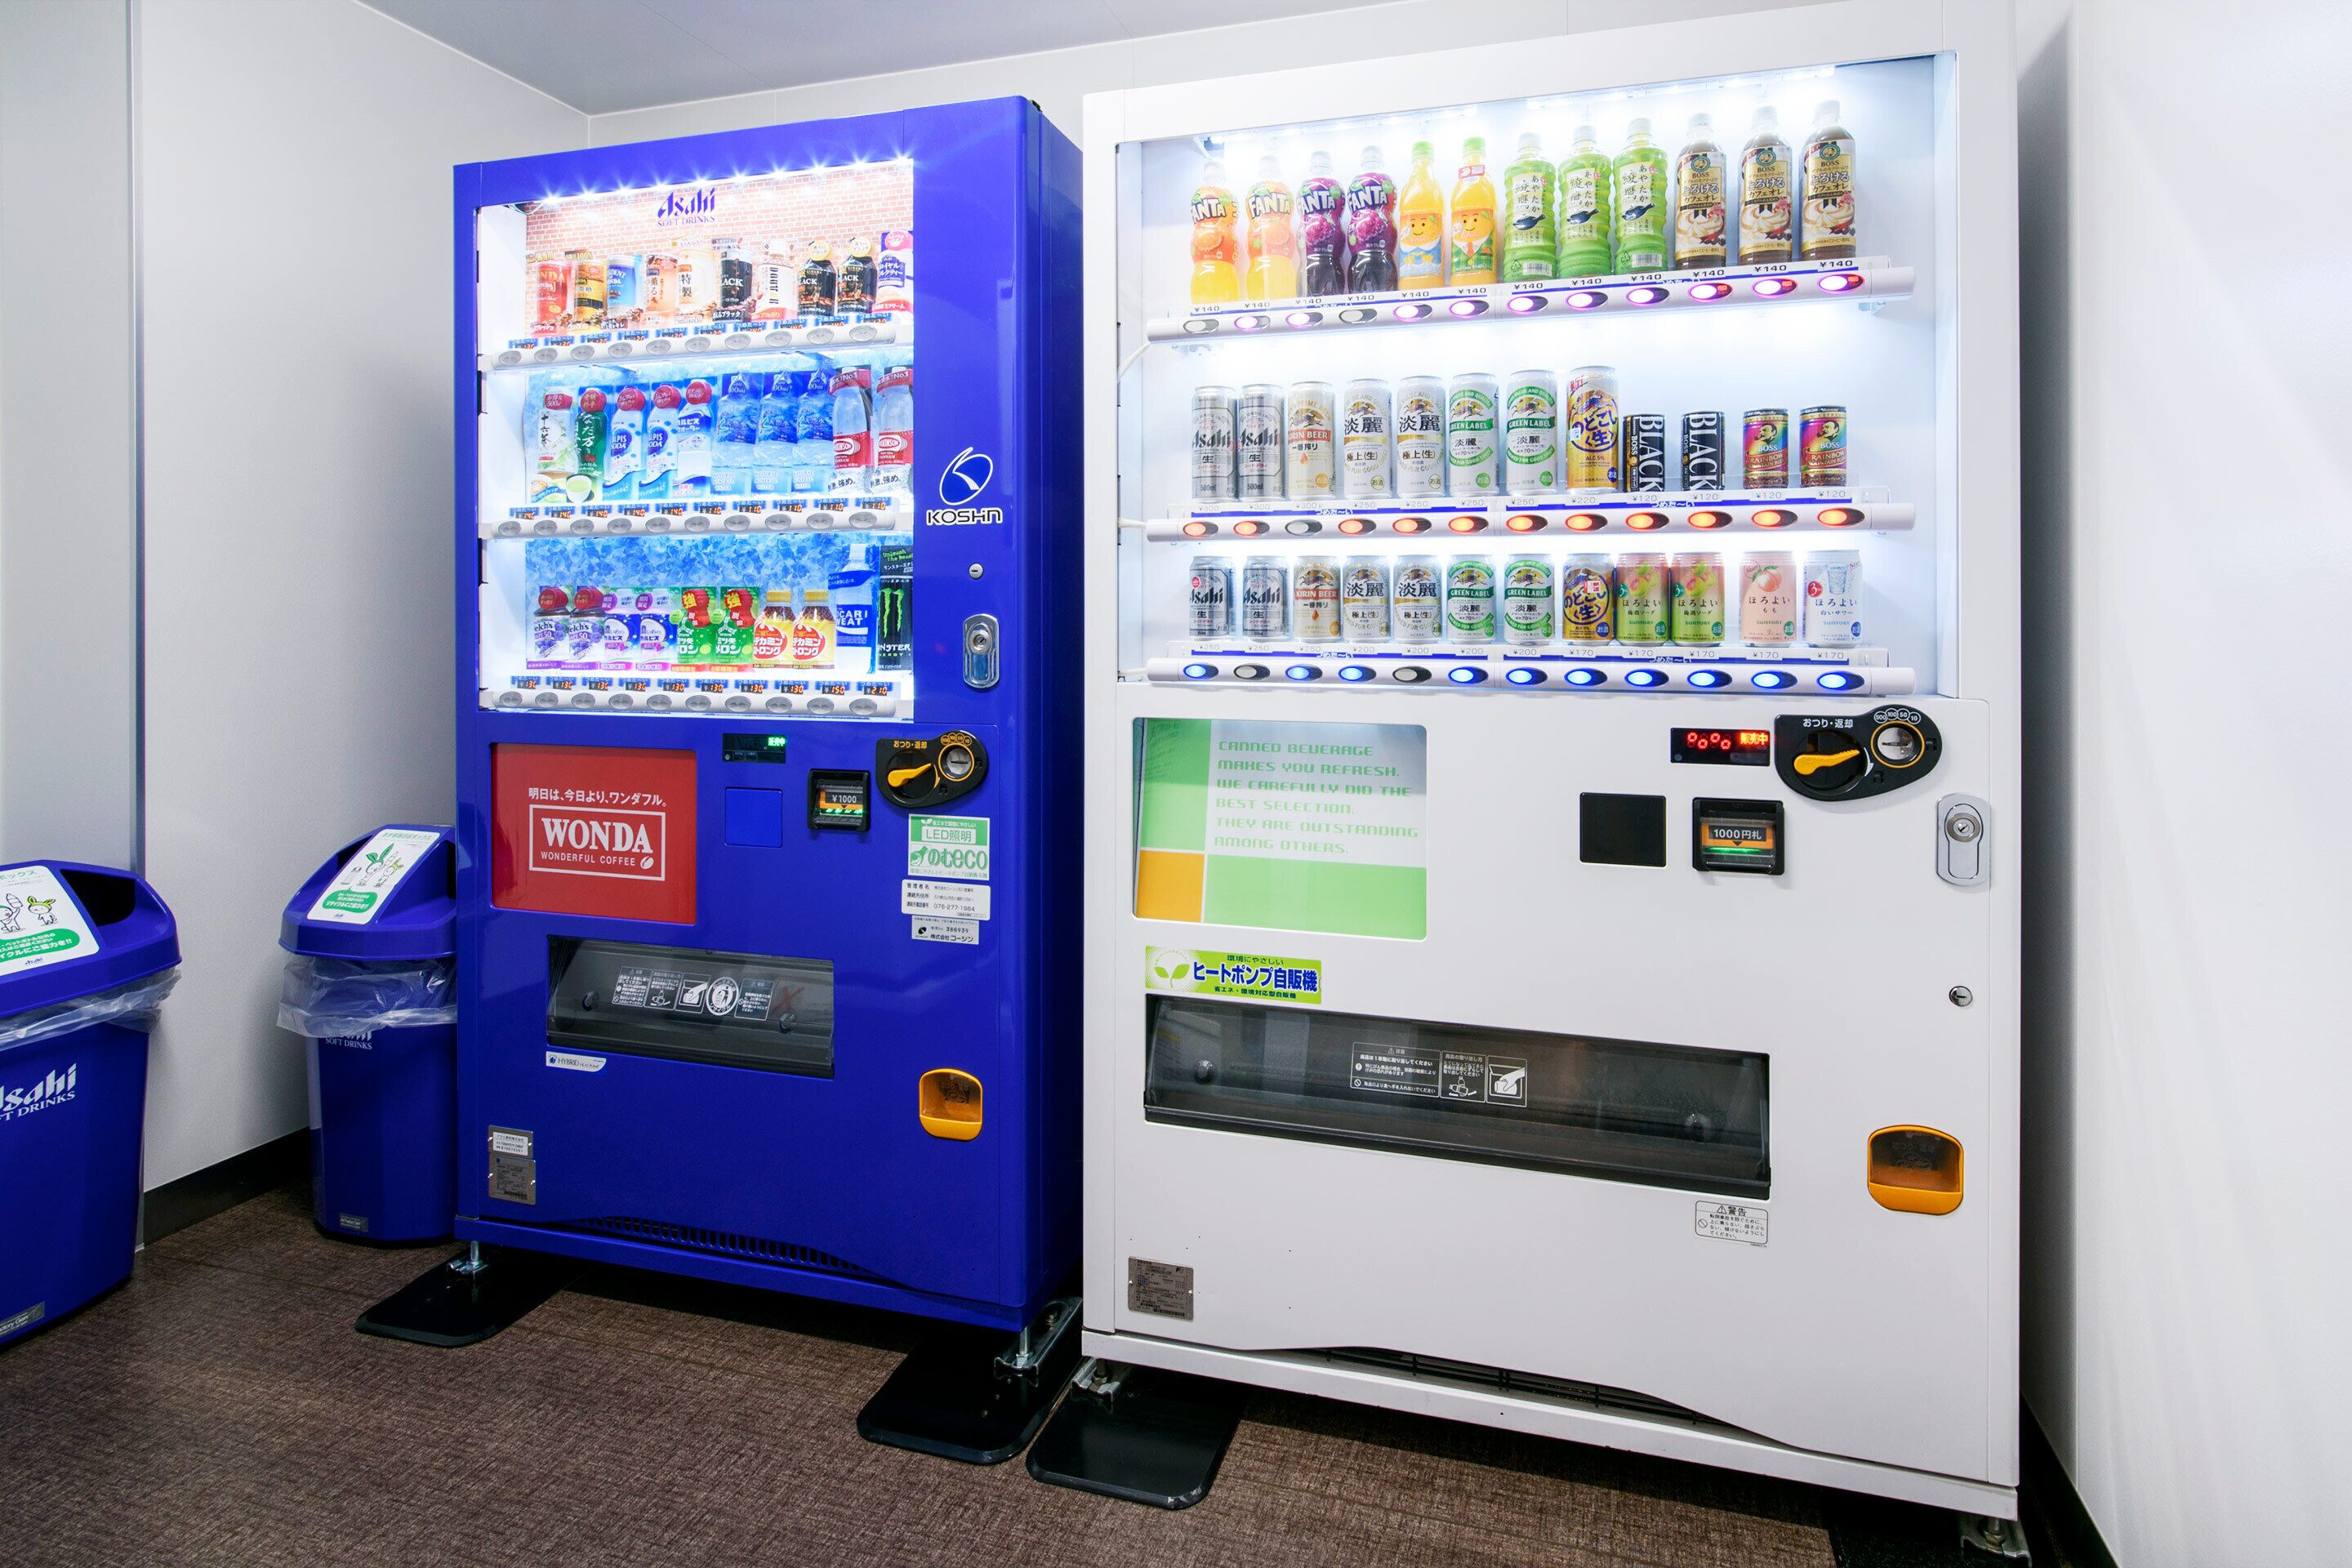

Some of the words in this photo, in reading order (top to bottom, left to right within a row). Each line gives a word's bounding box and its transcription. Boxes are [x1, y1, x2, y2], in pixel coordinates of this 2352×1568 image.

[1639, 165, 1649, 203] あやたか
[1748, 177, 1786, 190] とろける
[1811, 171, 1851, 185] とろける
[1682, 183, 1719, 196] とろける
[1748, 189, 1784, 198] カフェオレ
[1812, 183, 1849, 194] カフェオレ
[657, 187, 715, 219] Asahi
[1349, 185, 1388, 213] FANTA
[1683, 194, 1718, 203] カフェオレ
[1248, 192, 1291, 219] FANTA
[657, 219, 679, 227] SOFT
[682, 216, 715, 225] DRINKS
[1692, 270, 1725, 278] ¥140
[680, 274, 692, 296] 特製
[540, 413, 551, 448] 十六茶
[1344, 416, 1383, 435] 淡麗
[1399, 415, 1441, 434] 淡麗
[1192, 429, 1231, 449] Asahi
[1238, 428, 1278, 448] Asahi
[1307, 431, 1329, 440] BEER
[1687, 412, 1717, 491] BLACK
[1820, 442, 1841, 450] BOSS
[1249, 453, 1262, 464] 生
[1638, 415, 1664, 492] BLACK
[1246, 482, 1263, 491] 500ml
[1511, 497, 1535, 506] ¥250
[1692, 492, 1718, 501] ¥120
[1354, 501, 1375, 509] ¥250
[1242, 586, 1281, 605] Asahi
[1295, 590, 1316, 599] KIRIN
[1318, 590, 1339, 599] BEER
[1347, 582, 1385, 598] 淡麗
[1398, 582, 1437, 598] 淡麗
[1450, 589, 1470, 597] GREEN
[1470, 589, 1490, 597] LABEL
[1508, 588, 1526, 597] GREEN
[1527, 588, 1547, 596] LABEL
[683, 593, 697, 608] 強
[726, 593, 742, 609] 強
[1622, 598, 1661, 608] ほろよい
[1677, 598, 1718, 608] ほろよい
[1748, 595, 1791, 606] ほろよい
[1815, 598, 1858, 608] ほろよい
[1196, 610, 1207, 619] 生
[1253, 610, 1264, 619] 生
[1459, 604, 1481, 613] 淡麗
[1515, 604, 1537, 613] 淡麗
[1513, 648, 1537, 656] ¥200
[1689, 650, 1715, 658] ¥170
[1886, 710, 1897, 719] 100
[1898, 710, 1908, 719] 50
[1802, 718, 1854, 729] おつり・返却
[893, 741, 928, 750] おつり・返却
[1740, 733, 1769, 746] 販売中
[1218, 741, 1281, 753] CANNED
[1287, 744, 1374, 756] BEVERAGE
[1217, 760, 1276, 772] MAKES
[1281, 762, 1315, 773] YOU
[1321, 764, 1400, 777] REFRESH.
[1217, 778, 1241, 790] WE
[1248, 780, 1339, 794] CAREFULLY
[1345, 783, 1373, 795] DID
[1379, 786, 1411, 797] THE
[528, 787, 666, 808] 明日は、今日より、ワンダフル。
[832, 795, 858, 804] ¥1000
[1215, 798, 1256, 809] BEST
[1263, 800, 1354, 814] SELECTION.
[1215, 817, 1256, 830] THEY
[1263, 819, 1294, 831] ARE
[1299, 822, 1419, 838] OUTSTANDING
[1713, 828, 1762, 840] 1000円札
[541, 817, 653, 854] WONDA
[926, 828, 973, 843] LED照明
[1214, 835, 1274, 849] AMONG
[1280, 840, 1349, 854] OTHERS.
[541, 852, 595, 863] WONDERFUL
[600, 856, 635, 866] COFFEE
[928, 848, 988, 871] のむeco
[1227, 954, 1284, 966] 環境にやさしい
[1192, 960, 1318, 993] ヒートポンプ自販機
[1214, 986, 1297, 1000] 省エネ・環境対応型自販機
[325, 1037, 344, 1048] SOFT
[343, 1040, 372, 1050] DRINKS
[17, 1090, 76, 1117] DRINKS
[1727, 1205, 1747, 1217] 警告
